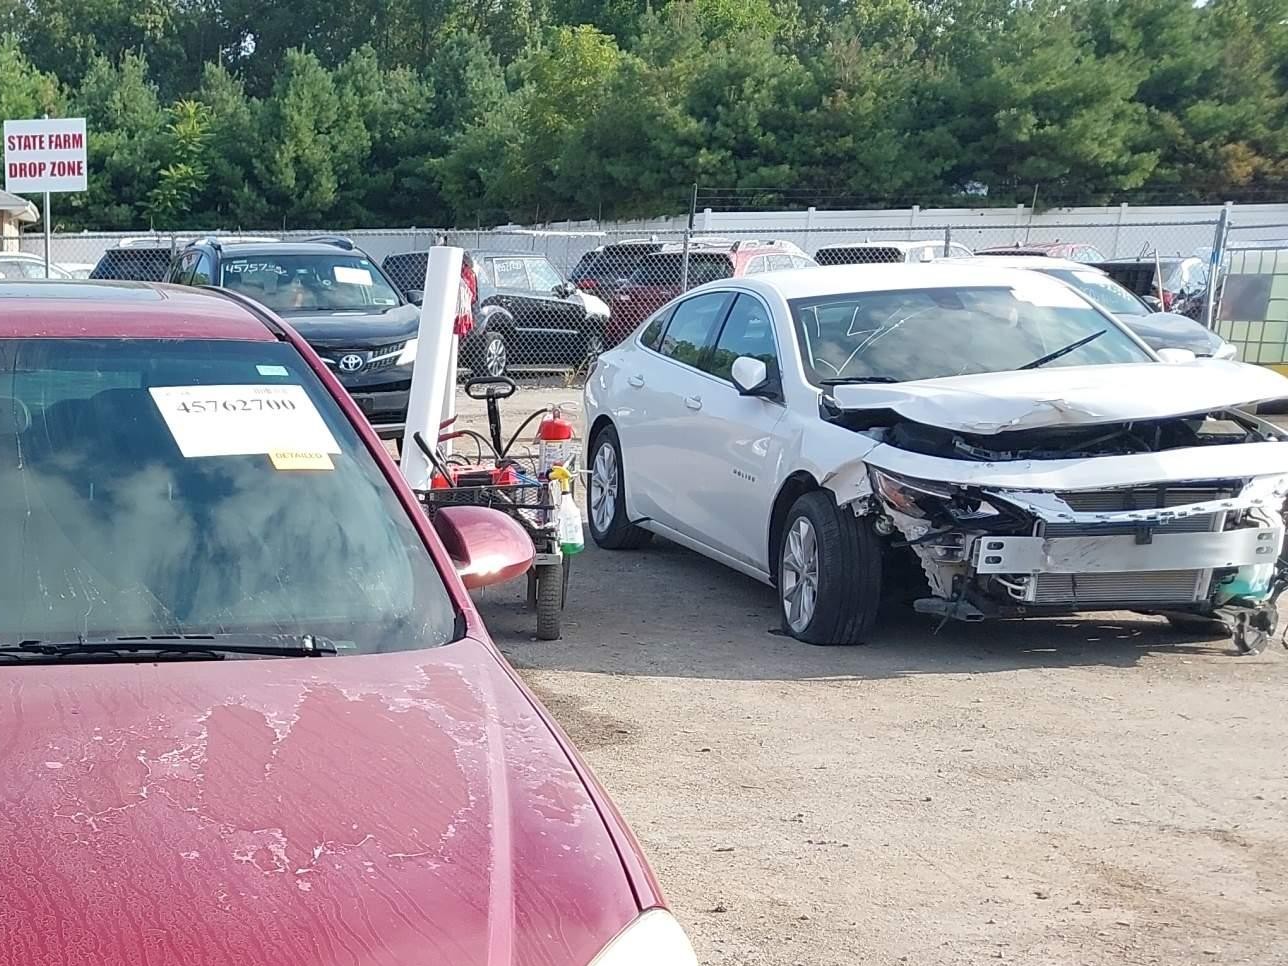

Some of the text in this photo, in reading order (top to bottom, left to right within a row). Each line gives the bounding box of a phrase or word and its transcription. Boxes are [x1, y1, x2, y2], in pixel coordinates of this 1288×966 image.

[8, 133, 83, 151] STATE FARM
[9, 161, 83, 178] DROP ZONE
[176, 399, 296, 414] 45762700
